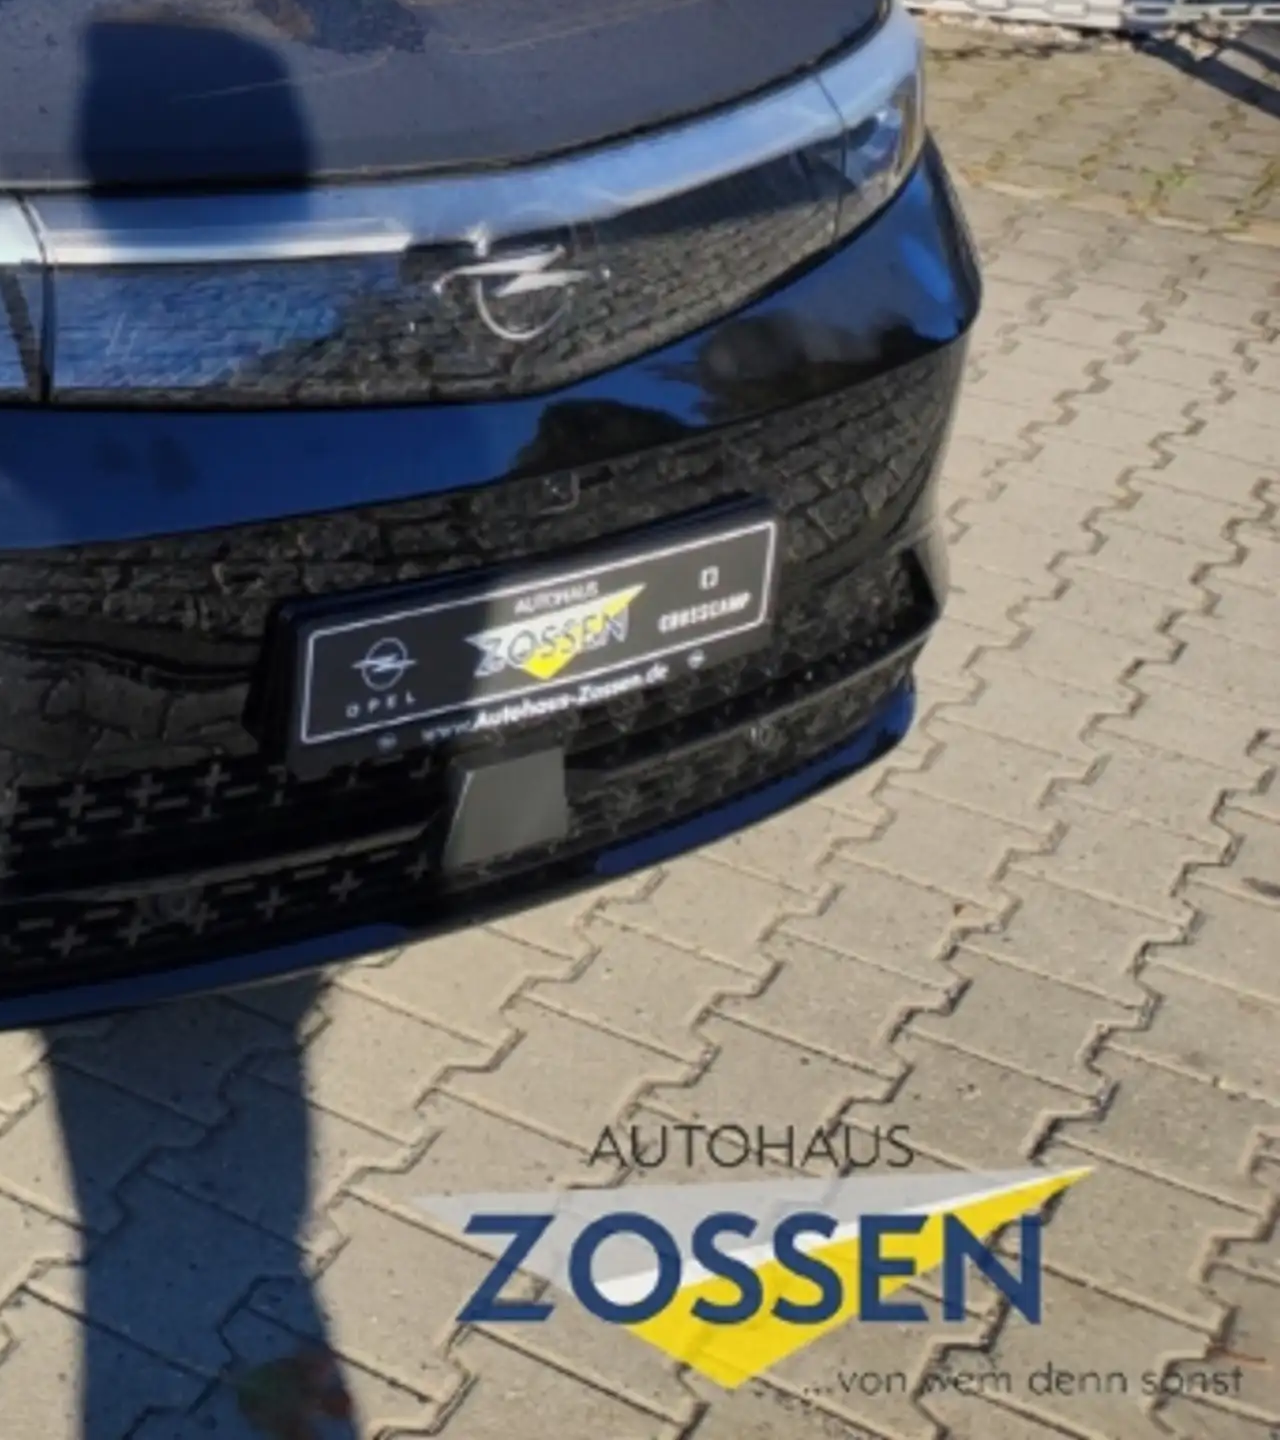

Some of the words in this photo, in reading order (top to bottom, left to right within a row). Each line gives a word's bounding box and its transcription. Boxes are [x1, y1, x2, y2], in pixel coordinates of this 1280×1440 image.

[514, 580, 599, 616] AUTOHAUS
[473, 604, 629, 678] ZOSSEN
[345, 689, 416, 719] OPEL
[421, 662, 669, 743] www.Autohaus-Zossen.de
